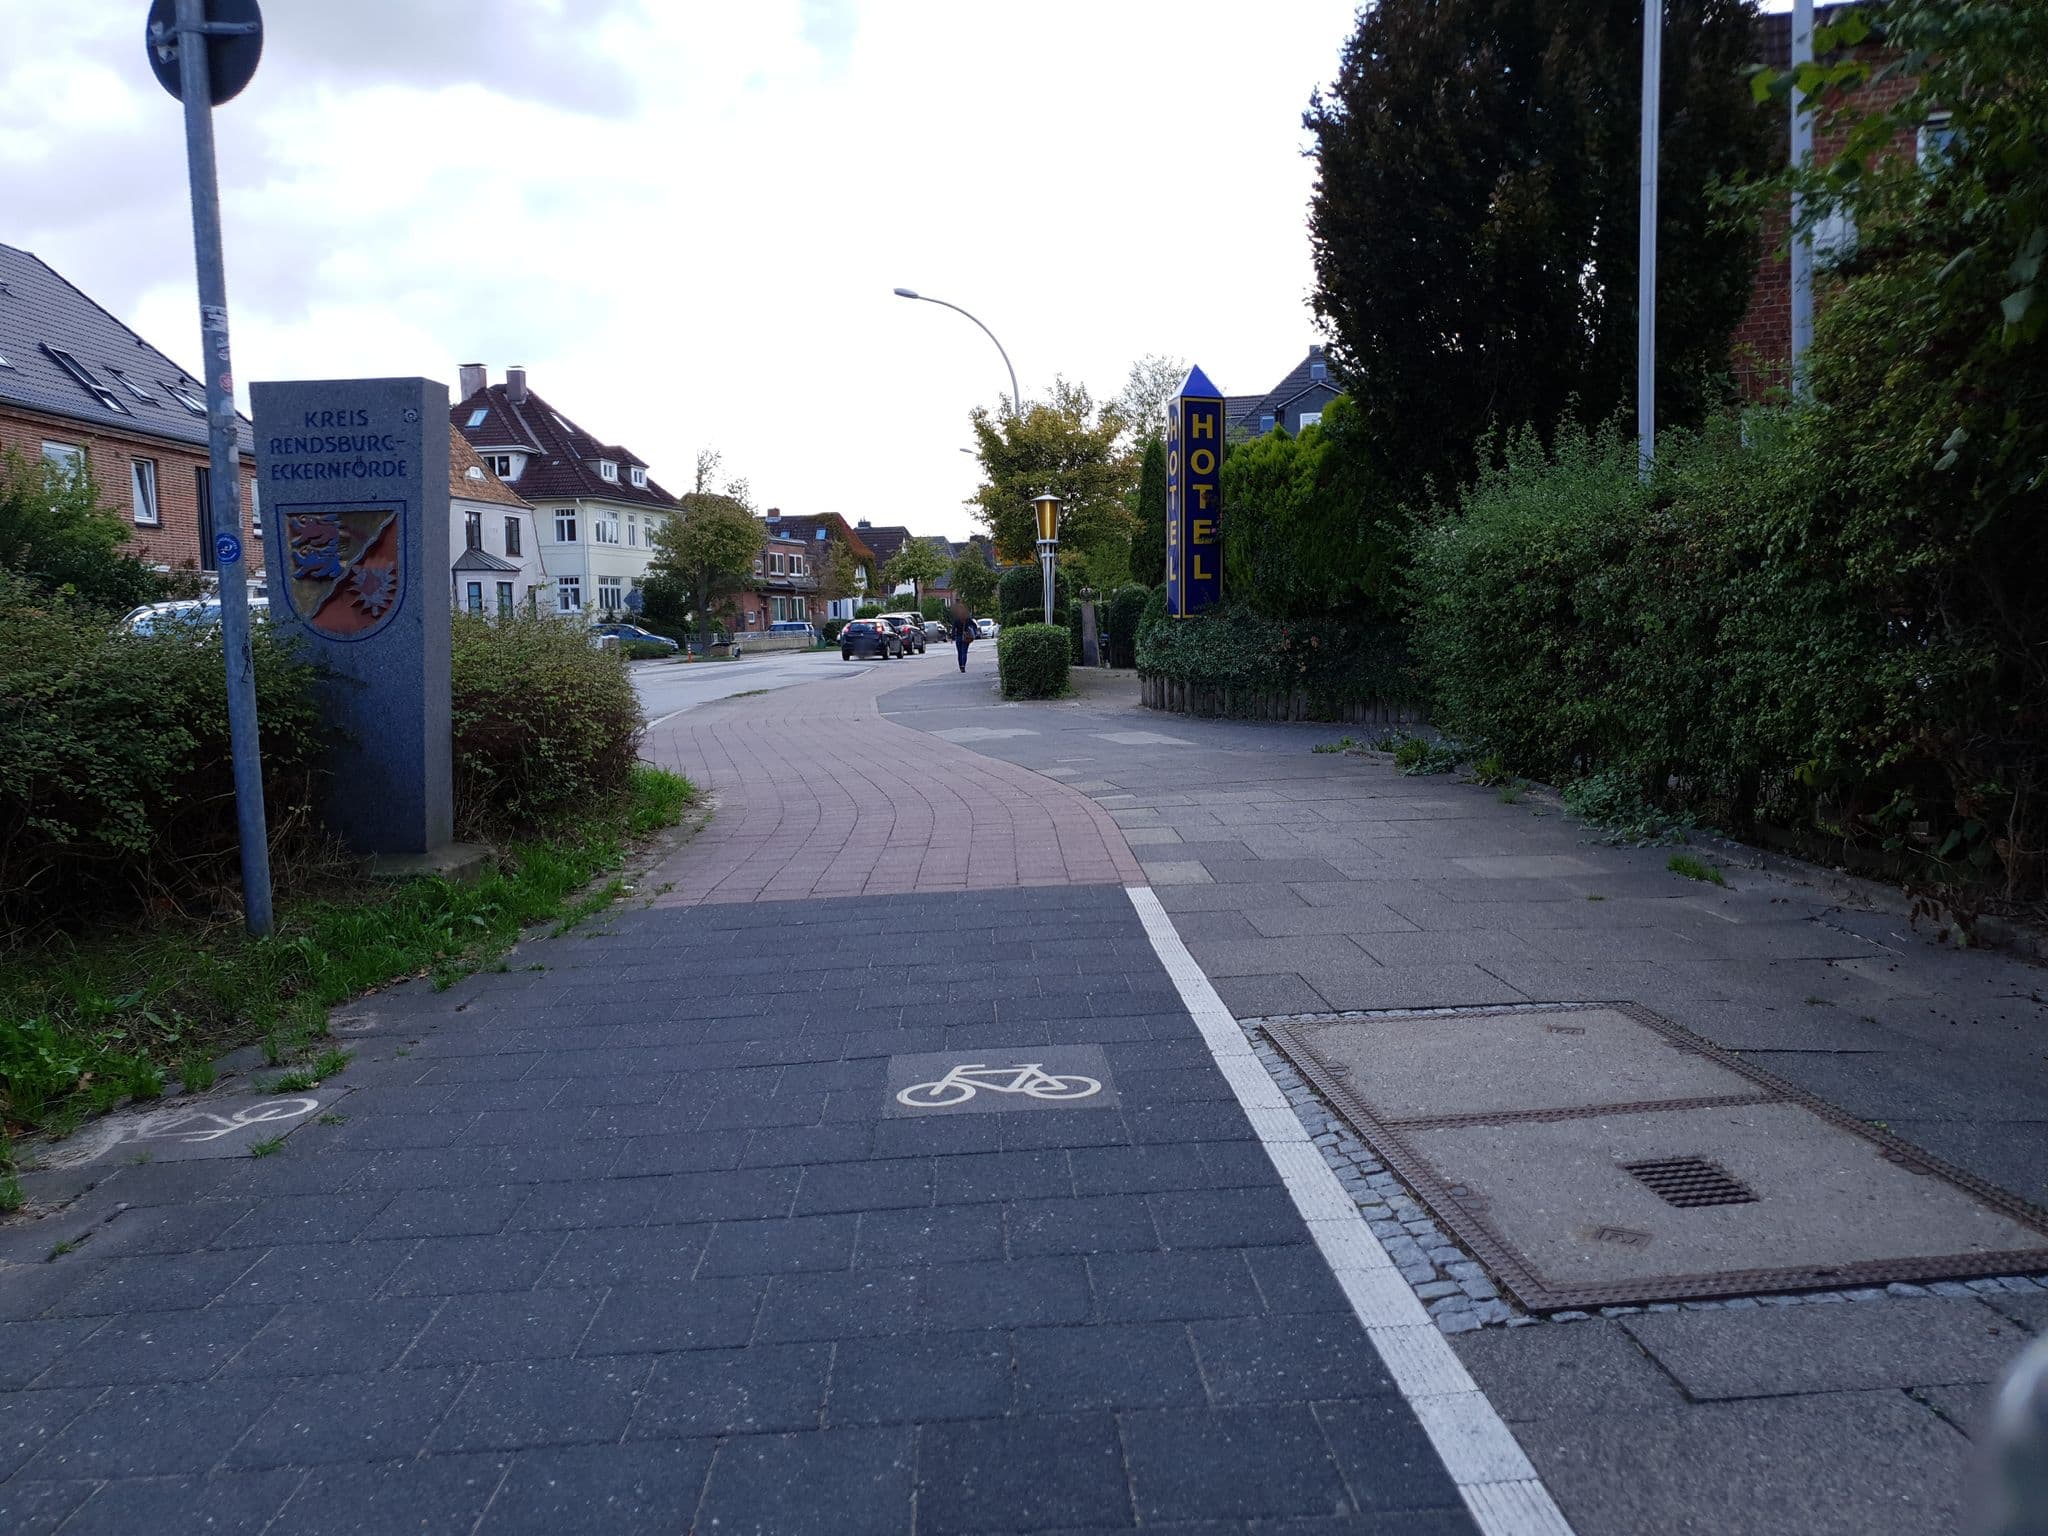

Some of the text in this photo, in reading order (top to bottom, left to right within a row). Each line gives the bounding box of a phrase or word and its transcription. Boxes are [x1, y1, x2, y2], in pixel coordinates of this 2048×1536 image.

[305, 409, 369, 428] KREIS
[270, 434, 406, 454] RENDSBURG-
[271, 455, 407, 480] ECKERNFÖRDE
[1169, 416, 1177, 581] HOTEL
[1191, 414, 1215, 580] HOTEL
